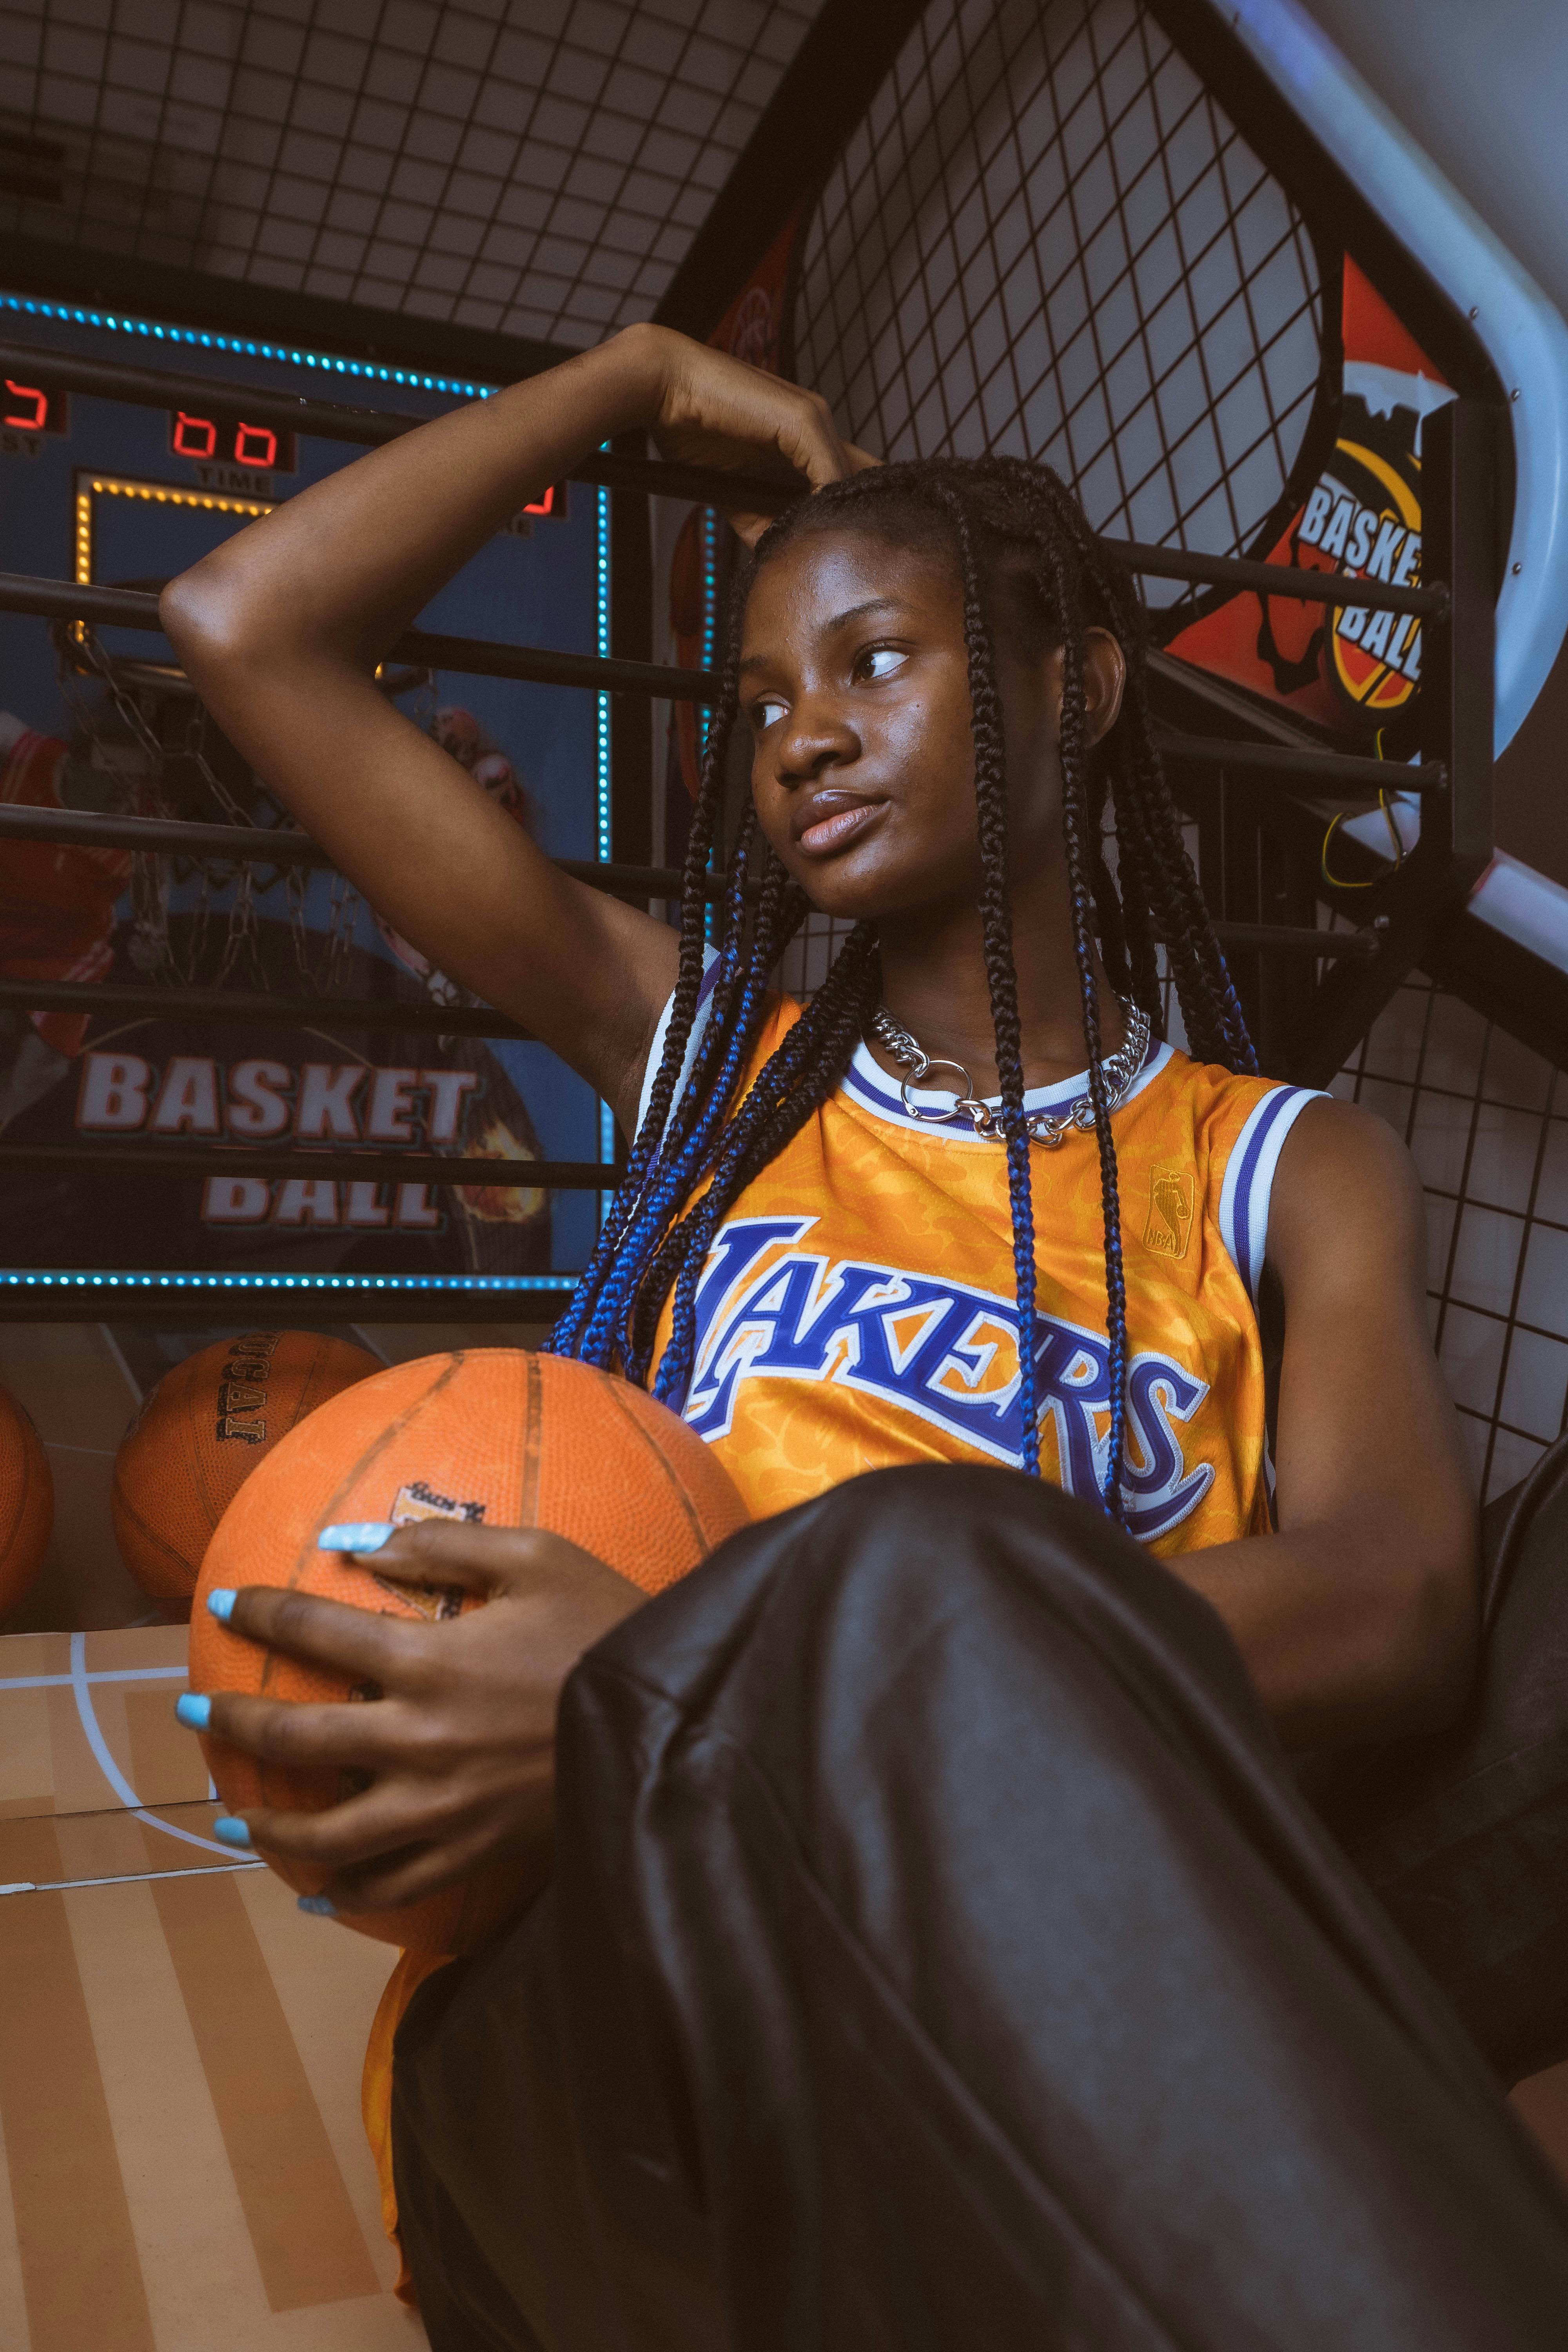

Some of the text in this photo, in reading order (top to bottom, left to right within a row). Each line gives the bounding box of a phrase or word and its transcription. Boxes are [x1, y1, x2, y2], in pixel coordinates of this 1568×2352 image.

[197, 466, 270, 493] TIME
[1297, 485, 1422, 588] BASKE
[75, 1051, 478, 1143] BASKET
[201, 1149, 442, 1226] BALL
[1146, 1228, 1176, 1252] NBA
[655, 1214, 1216, 1543] LAKERS
